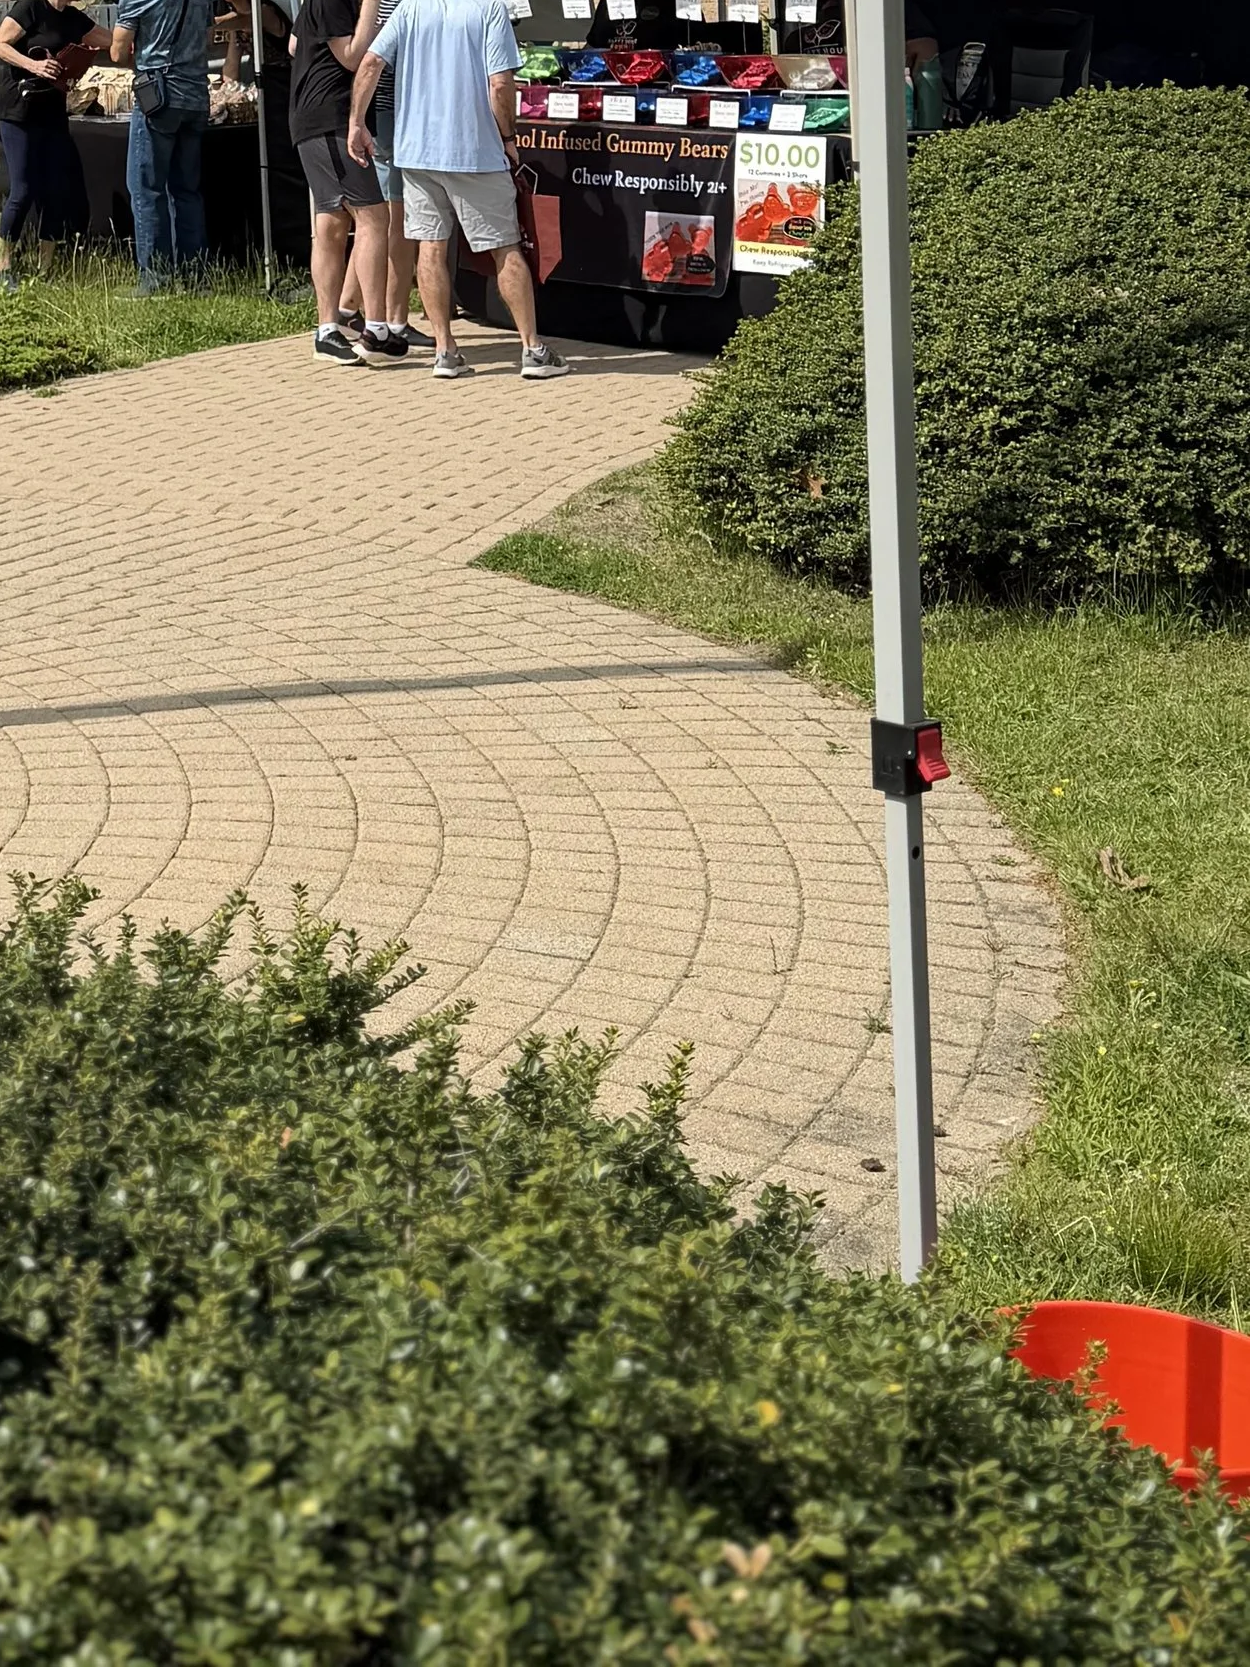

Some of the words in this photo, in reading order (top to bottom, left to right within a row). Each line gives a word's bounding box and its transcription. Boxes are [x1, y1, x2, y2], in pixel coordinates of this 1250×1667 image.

[540, 130, 601, 152] Infused
[606, 133, 675, 161] Gummy
[679, 137, 729, 159] Bears
[739, 140, 820, 169] $10.00
[572, 167, 612, 186] Chew
[614, 169, 704, 198] Responsibly
[707, 181, 728, 195] 21+
